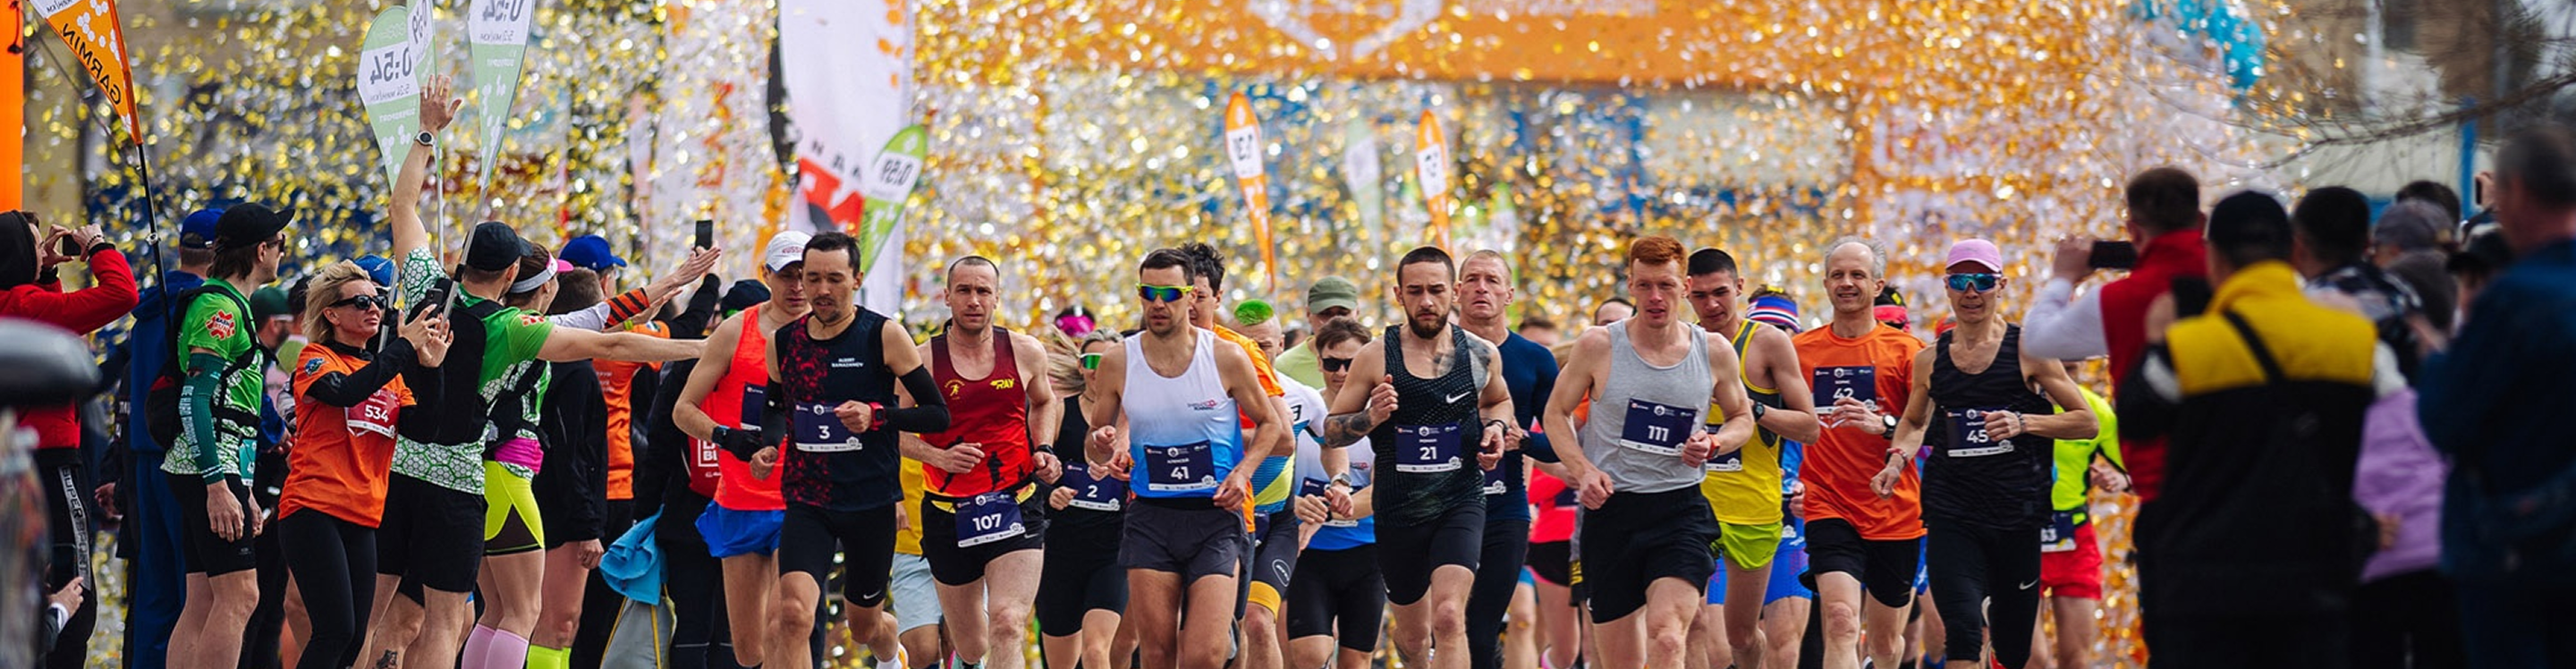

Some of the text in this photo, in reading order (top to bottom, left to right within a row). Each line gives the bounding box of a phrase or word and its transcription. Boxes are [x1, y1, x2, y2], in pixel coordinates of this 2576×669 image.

[995, 378, 1015, 390] RAY
[1833, 387, 1854, 400] 42
[364, 404, 390, 423] 534
[818, 425, 831, 439] 3
[1648, 425, 1669, 442] 111
[1966, 429, 1989, 444] 45
[1419, 446, 1437, 461] 21
[1170, 466, 1190, 479] 41
[1087, 485, 1098, 498] 2
[972, 513, 1002, 531] 107
